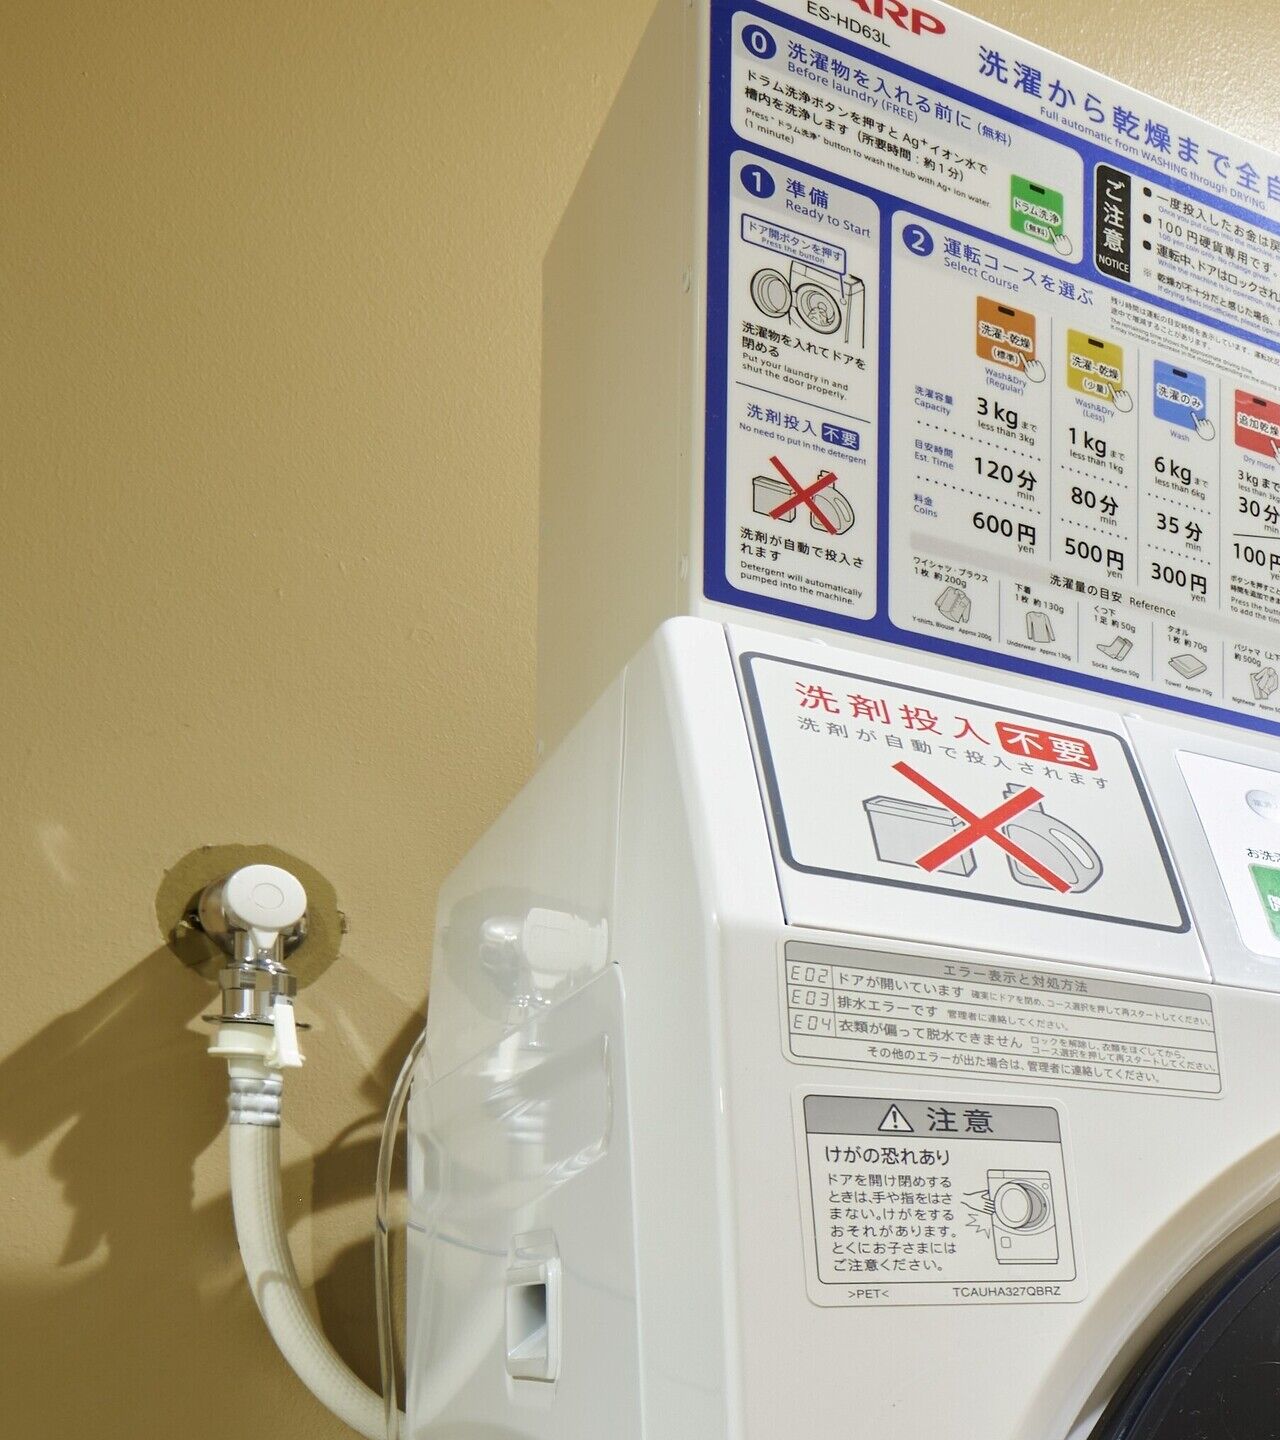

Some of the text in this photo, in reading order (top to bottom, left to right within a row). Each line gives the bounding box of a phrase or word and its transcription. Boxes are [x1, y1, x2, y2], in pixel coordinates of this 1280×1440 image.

[807, 1, 890, 47] ES-HD63L
[751, 31, 766, 52] 0
[787, 41, 972, 130] 洗濯物を入れる前に
[788, 62, 918, 123] Before laundry (FREE)
[1040, 107, 1266, 210] Full automatic from WASHING through DRYING
[752, 172, 762, 192] 1
[786, 178, 828, 209] 準備
[786, 200, 870, 238] Ready to Start
[1104, 179, 1126, 253] ご注意
[748, 222, 843, 262] ドア開ボタンを押す
[911, 230, 925, 251] 2
[944, 237, 1093, 305] 運転コースを選ぶ
[944, 256, 1019, 292] Select Course
[1099, 254, 1130, 274] NOTICE
[742, 321, 866, 370] 洗濯物を入れてドアを
[742, 337, 779, 357] 閉める
[742, 353, 848, 391] Put your laundry in and
[985, 368, 1027, 388] Wash&Dry
[915, 385, 954, 405] 洗濯容量
[986, 377, 1024, 396] (Regular)
[1157, 385, 1202, 409] 洗濯のみ
[915, 398, 951, 416] Capacity
[747, 403, 858, 448] 洗剤投入 不要
[1170, 429, 1190, 443] Wash
[1238, 414, 1280, 437] 追加乾燥
[915, 439, 953, 459] 目安時間
[915, 452, 954, 470] Est. Time
[1243, 454, 1275, 472] Dry more
[975, 457, 1037, 491] 120分
[914, 493, 933, 507] 料金
[914, 505, 938, 518] Coins
[1072, 487, 1119, 516] 80分
[1238, 496, 1280, 525] 30分
[973, 512, 1036, 545] 600円
[1157, 513, 1202, 542] 35分
[740, 527, 864, 568] 洗剤が自動で投入さ
[741, 544, 781, 561] れます
[1065, 537, 1123, 571] 500円
[1152, 563, 1207, 594] 300円
[1050, 573, 1176, 618] 洗濯量の目安 Reference
[795, 682, 1092, 769] 洗剤投入 不要
[797, 715, 1109, 790] 洗剤が自動で投入されます
[838, 971, 964, 999] ドアが開いています
[943, 964, 1088, 994] エラー表示と対処方法
[837, 995, 939, 1018] 排水エラーです
[838, 1019, 1023, 1049] 衣類が偏って脱水できません
[928, 1106, 994, 1134] 注意
[825, 1146, 950, 1166] けがの恐れあり
[828, 1173, 952, 1188] ドアを開け閉めする
[829, 1191, 953, 1206] ときは、手や指をはさ
[830, 1208, 954, 1221] まない。けがをする
[830, 1224, 957, 1238] おそれがあります。
[832, 1242, 957, 1256] とくにお子さまには
[834, 1258, 943, 1272] ご注意ください。
[848, 1288, 889, 1299] >PET<
